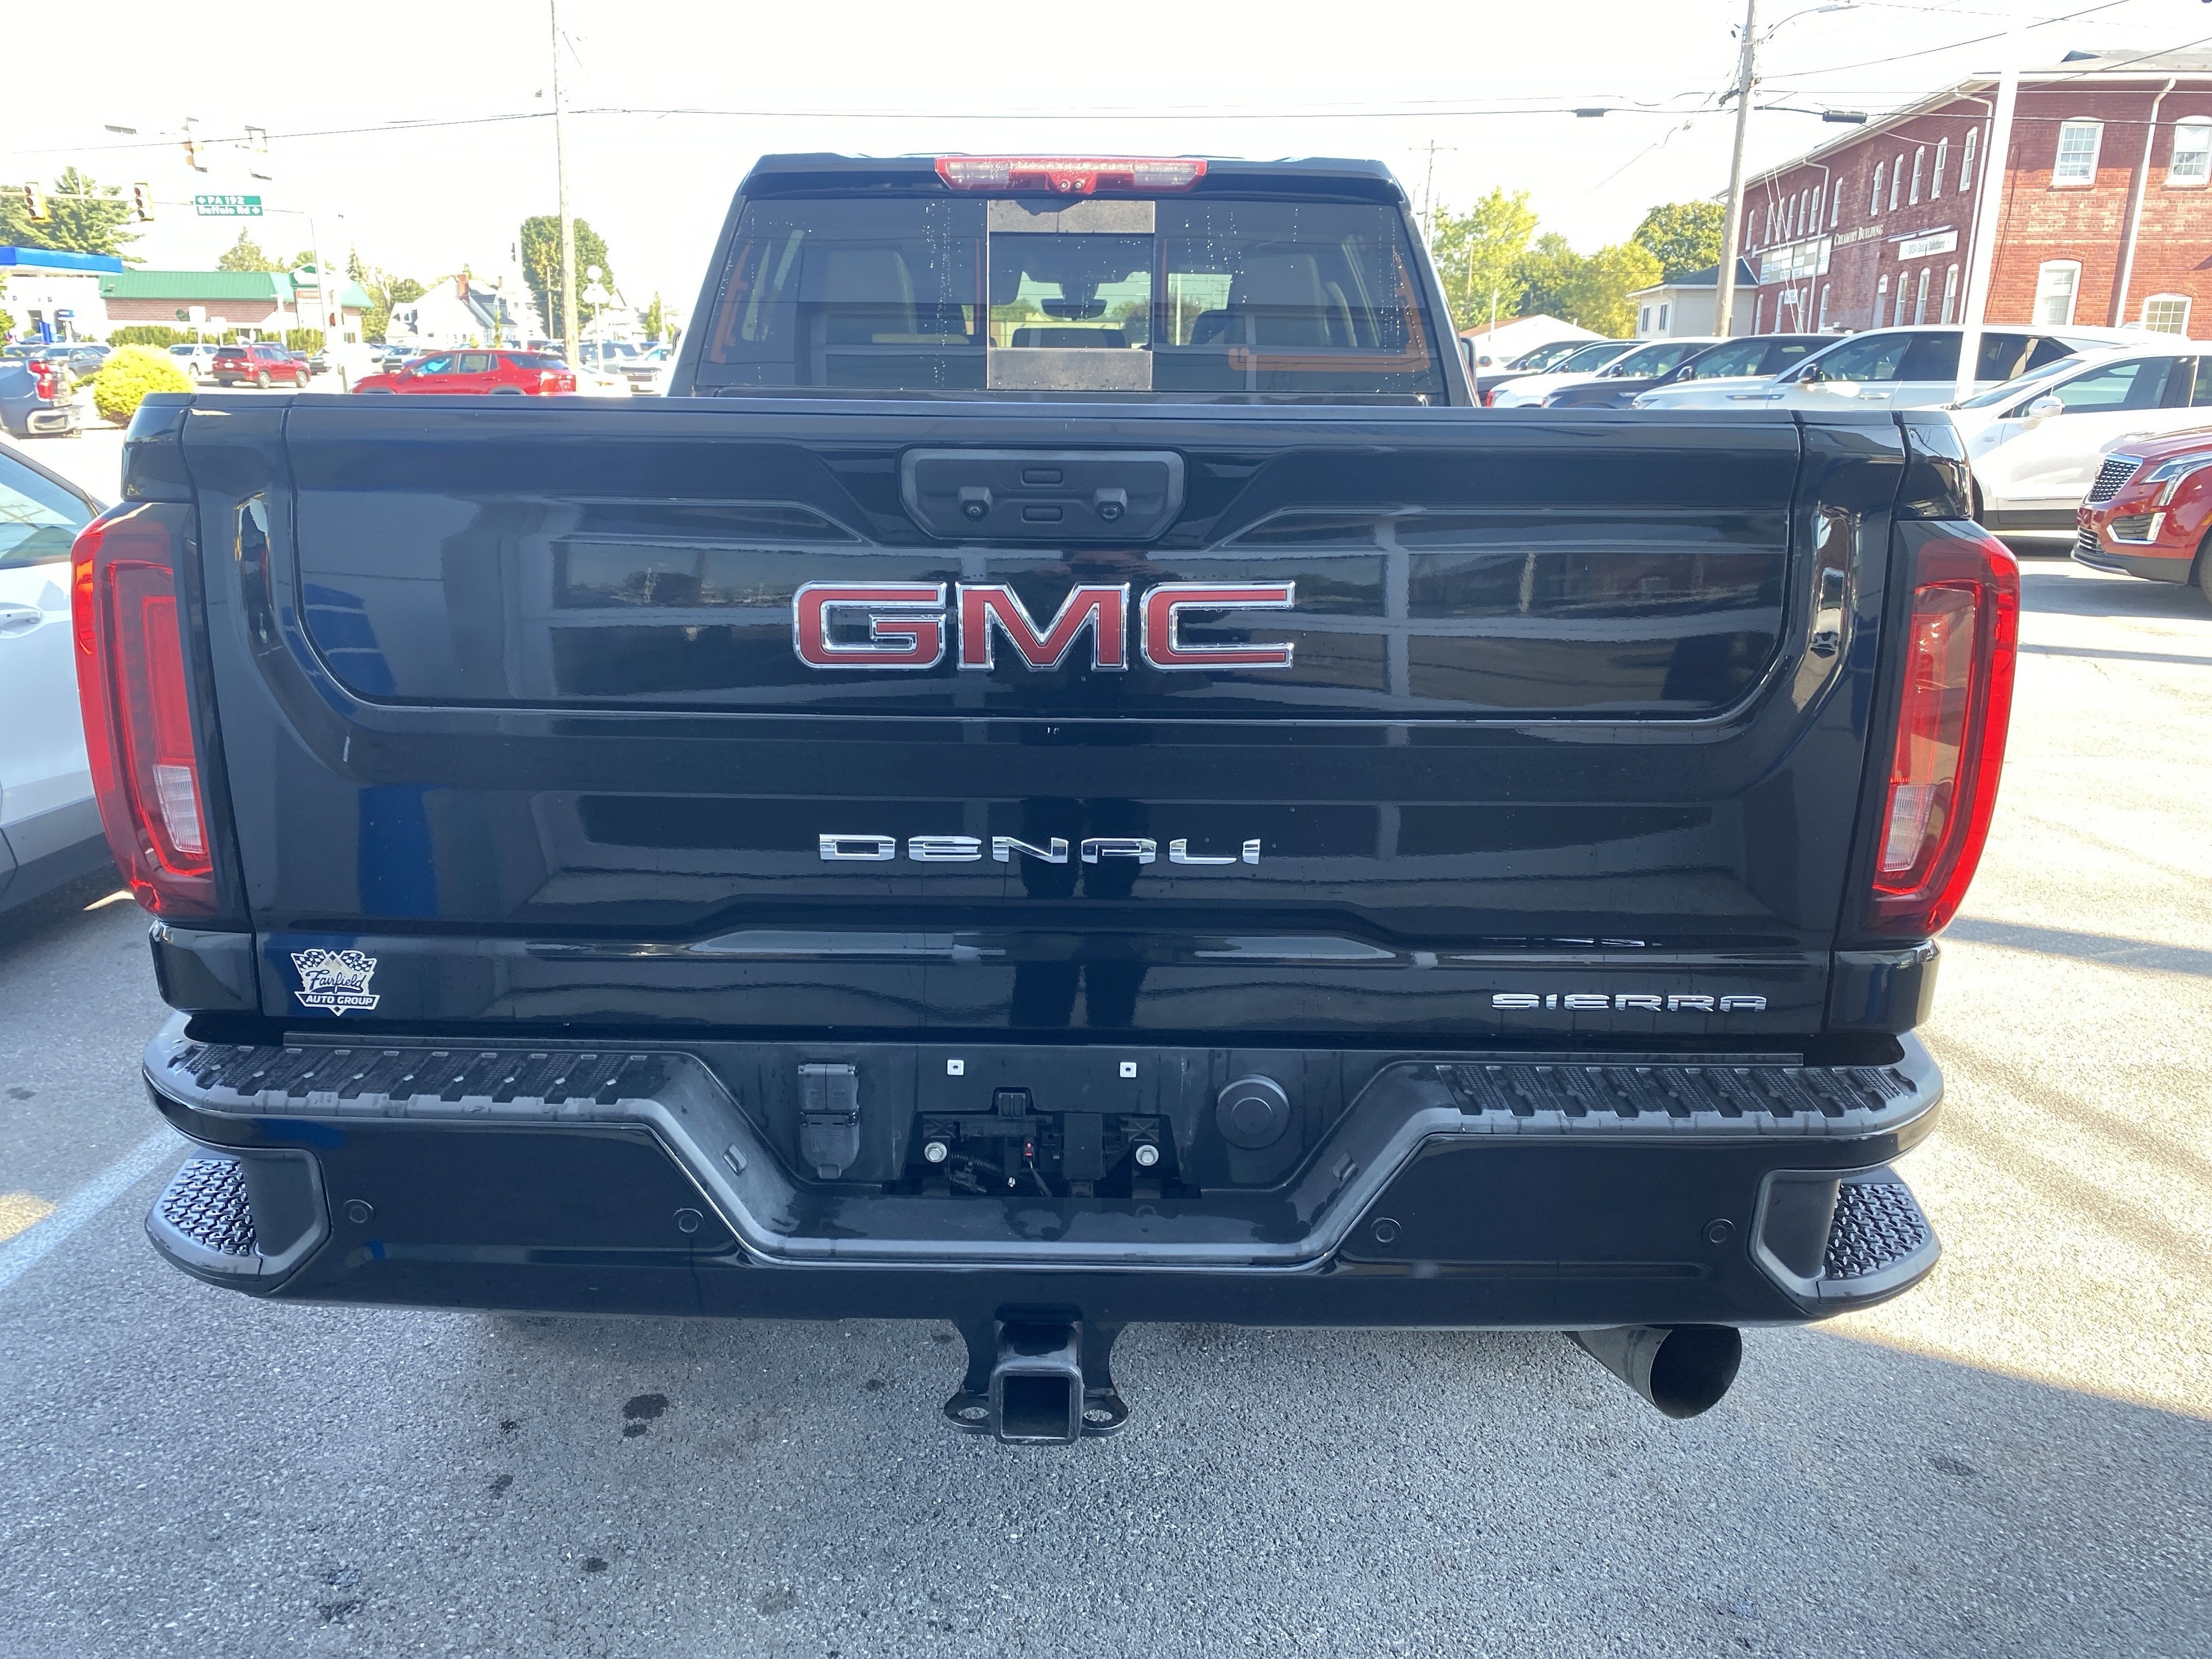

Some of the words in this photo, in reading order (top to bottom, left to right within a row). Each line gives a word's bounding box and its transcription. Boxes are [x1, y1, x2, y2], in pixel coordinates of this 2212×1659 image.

[207, 196, 223, 205] PA
[224, 196, 245, 205] 192
[198, 206, 235, 215] Buffalo
[236, 206, 251, 215] Rd
[792, 580, 1296, 672] GMC
[819, 833, 1260, 864] DENALI
[306, 969, 366, 991] Fairfield
[306, 995, 335, 1004] AUTO
[337, 996, 373, 1005] GROUP
[1492, 994, 1767, 1012] SIERRA
